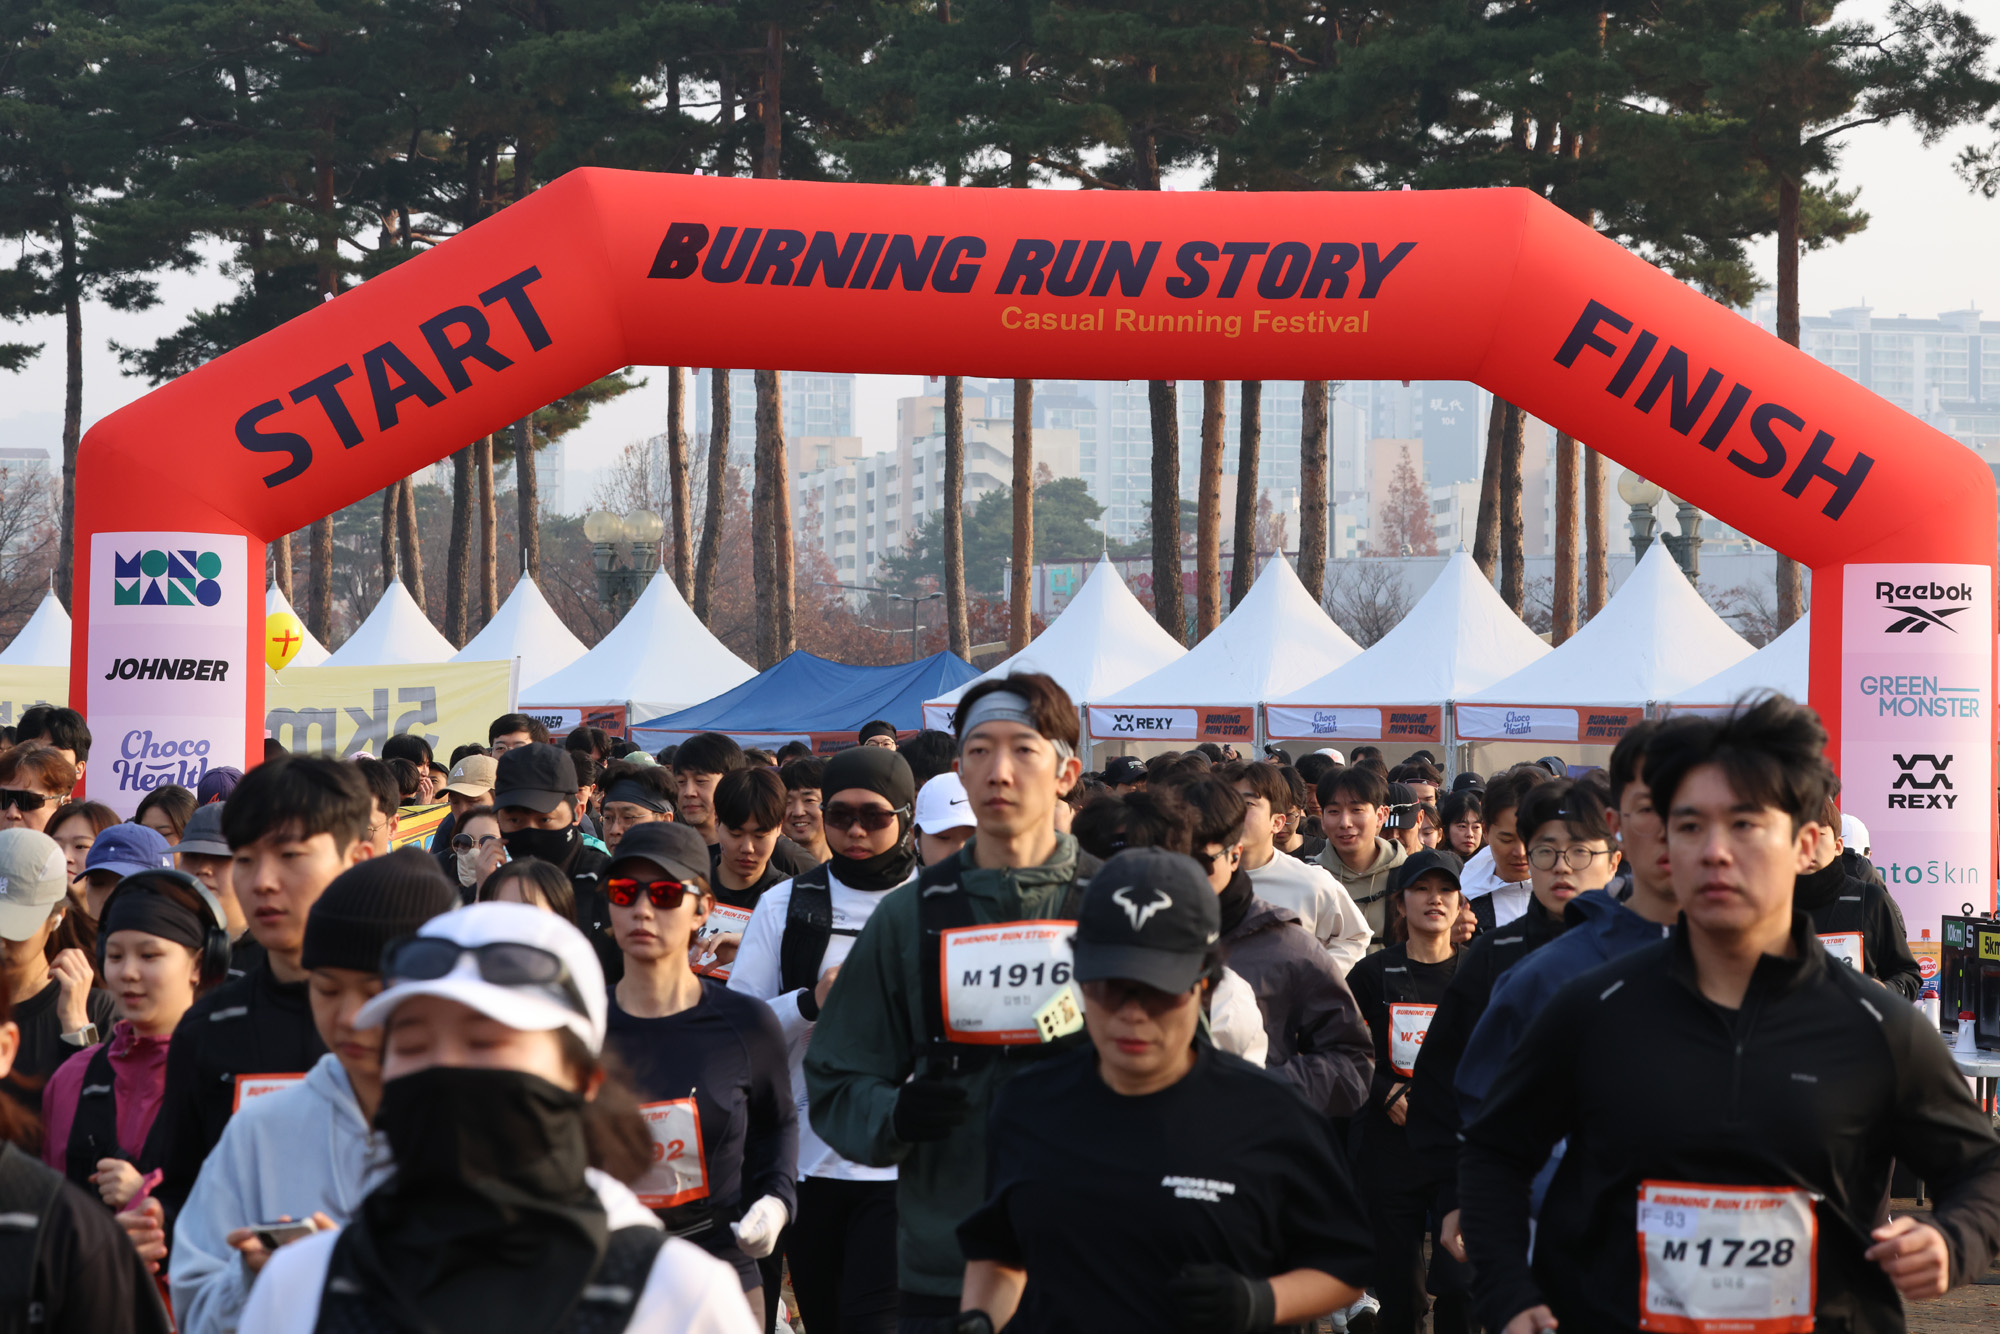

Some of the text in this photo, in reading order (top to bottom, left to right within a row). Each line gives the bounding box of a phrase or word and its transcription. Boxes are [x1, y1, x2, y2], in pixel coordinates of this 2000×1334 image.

[647, 222, 1419, 300] BURNING RUN STORY
[1001, 306, 1369, 338] Casual Running Festival
[235, 265, 553, 489] START
[1553, 298, 1875, 521] FINISH
[1876, 582, 1972, 603] Reebok
[105, 658, 229, 681] JOHNBER
[1860, 676, 1937, 695] GREEN
[1879, 697, 1979, 717] MONSTER
[1205, 714, 1241, 724] BURNING
[1313, 712, 1336, 722] Choco
[1389, 713, 1428, 724] BURNING
[1505, 711, 1530, 722] Choco
[1587, 715, 1628, 725] BURNING
[1136, 718, 1173, 730] REXY
[1204, 725, 1250, 735] RUN STORY
[1312, 722, 1337, 733] Health
[1388, 725, 1437, 735] RUN STORY
[1504, 722, 1531, 734] Health
[1586, 727, 1606, 736] RUN
[121, 730, 210, 759] Choco
[1888, 794, 1958, 809] REXY
[1875, 861, 1977, 884] ntoSkin
